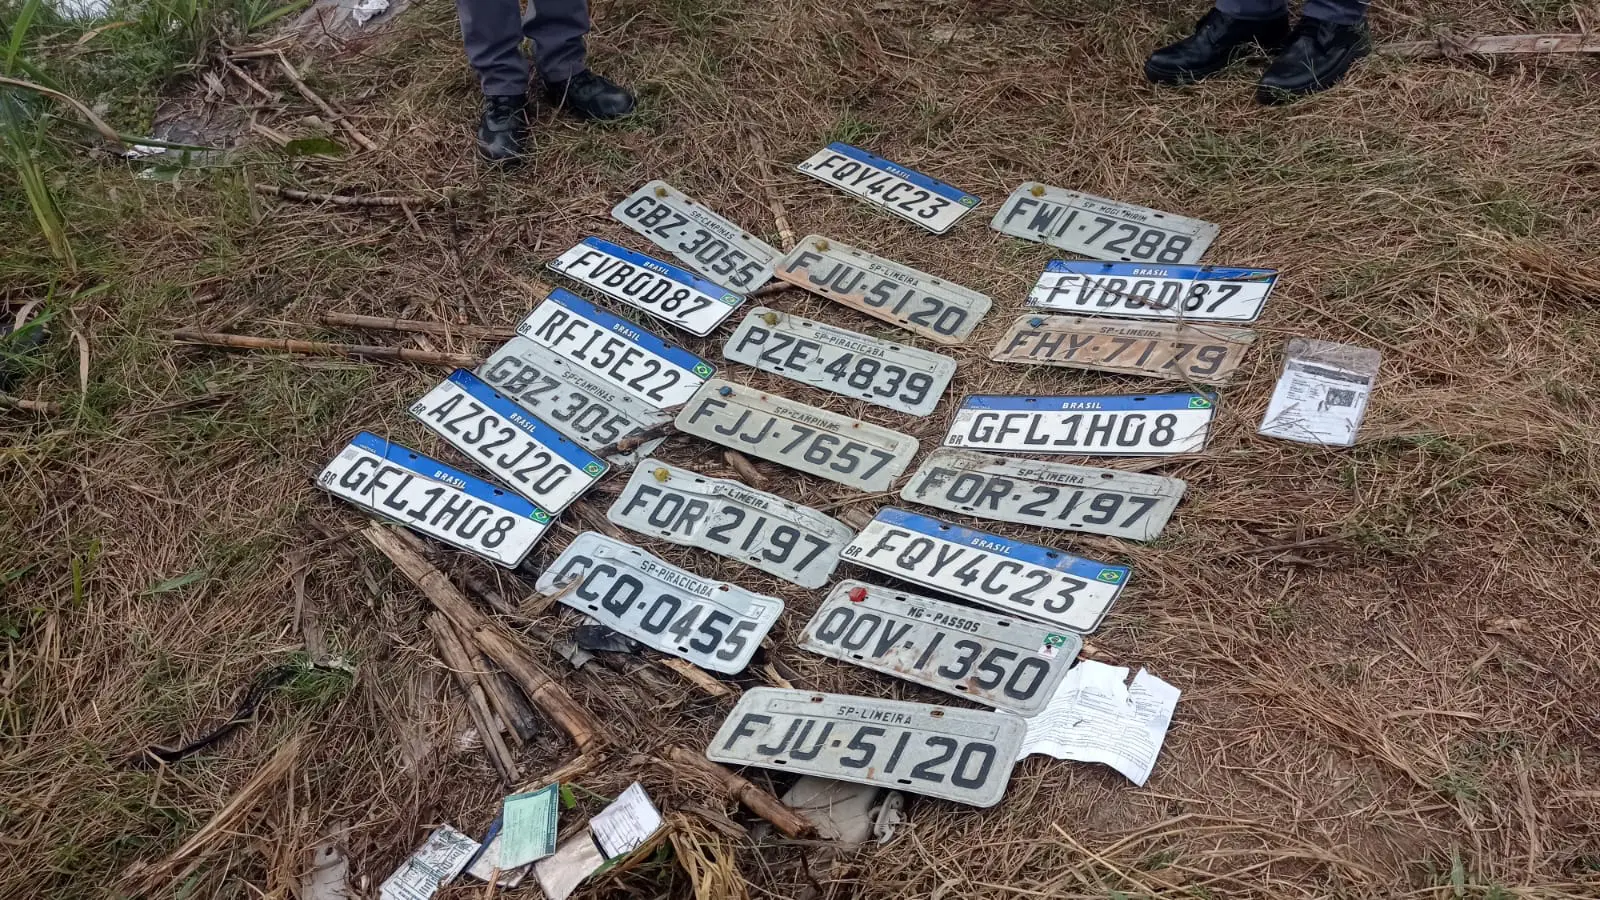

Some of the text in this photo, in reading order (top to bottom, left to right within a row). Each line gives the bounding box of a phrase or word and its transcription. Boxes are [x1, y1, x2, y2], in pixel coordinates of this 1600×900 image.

[885, 166, 910, 179] BRASIL
[813, 155, 951, 219] FQY4C23
[643, 261, 669, 275] BRASIL
[1132, 268, 1169, 277] BRASIL
[518, 322, 531, 334] BR
[612, 323, 640, 342] BRASIL
[534, 309, 681, 402] RFI5E22
[412, 403, 426, 416] BR
[509, 412, 536, 433] BRASIL
[967, 412, 1178, 447] GFL1H08
[427, 393, 572, 495] AZS2J20
[948, 434, 963, 445] BR
[321, 470, 337, 485] BR
[434, 470, 467, 489] BRASIL
[339, 456, 516, 549] GFL1H08
[846, 544, 862, 557] BR
[970, 537, 1011, 555] BRASIL
[866, 529, 1089, 614] FQY4C23
[907, 607, 924, 619] MG
[933, 612, 981, 633] PASSOS
